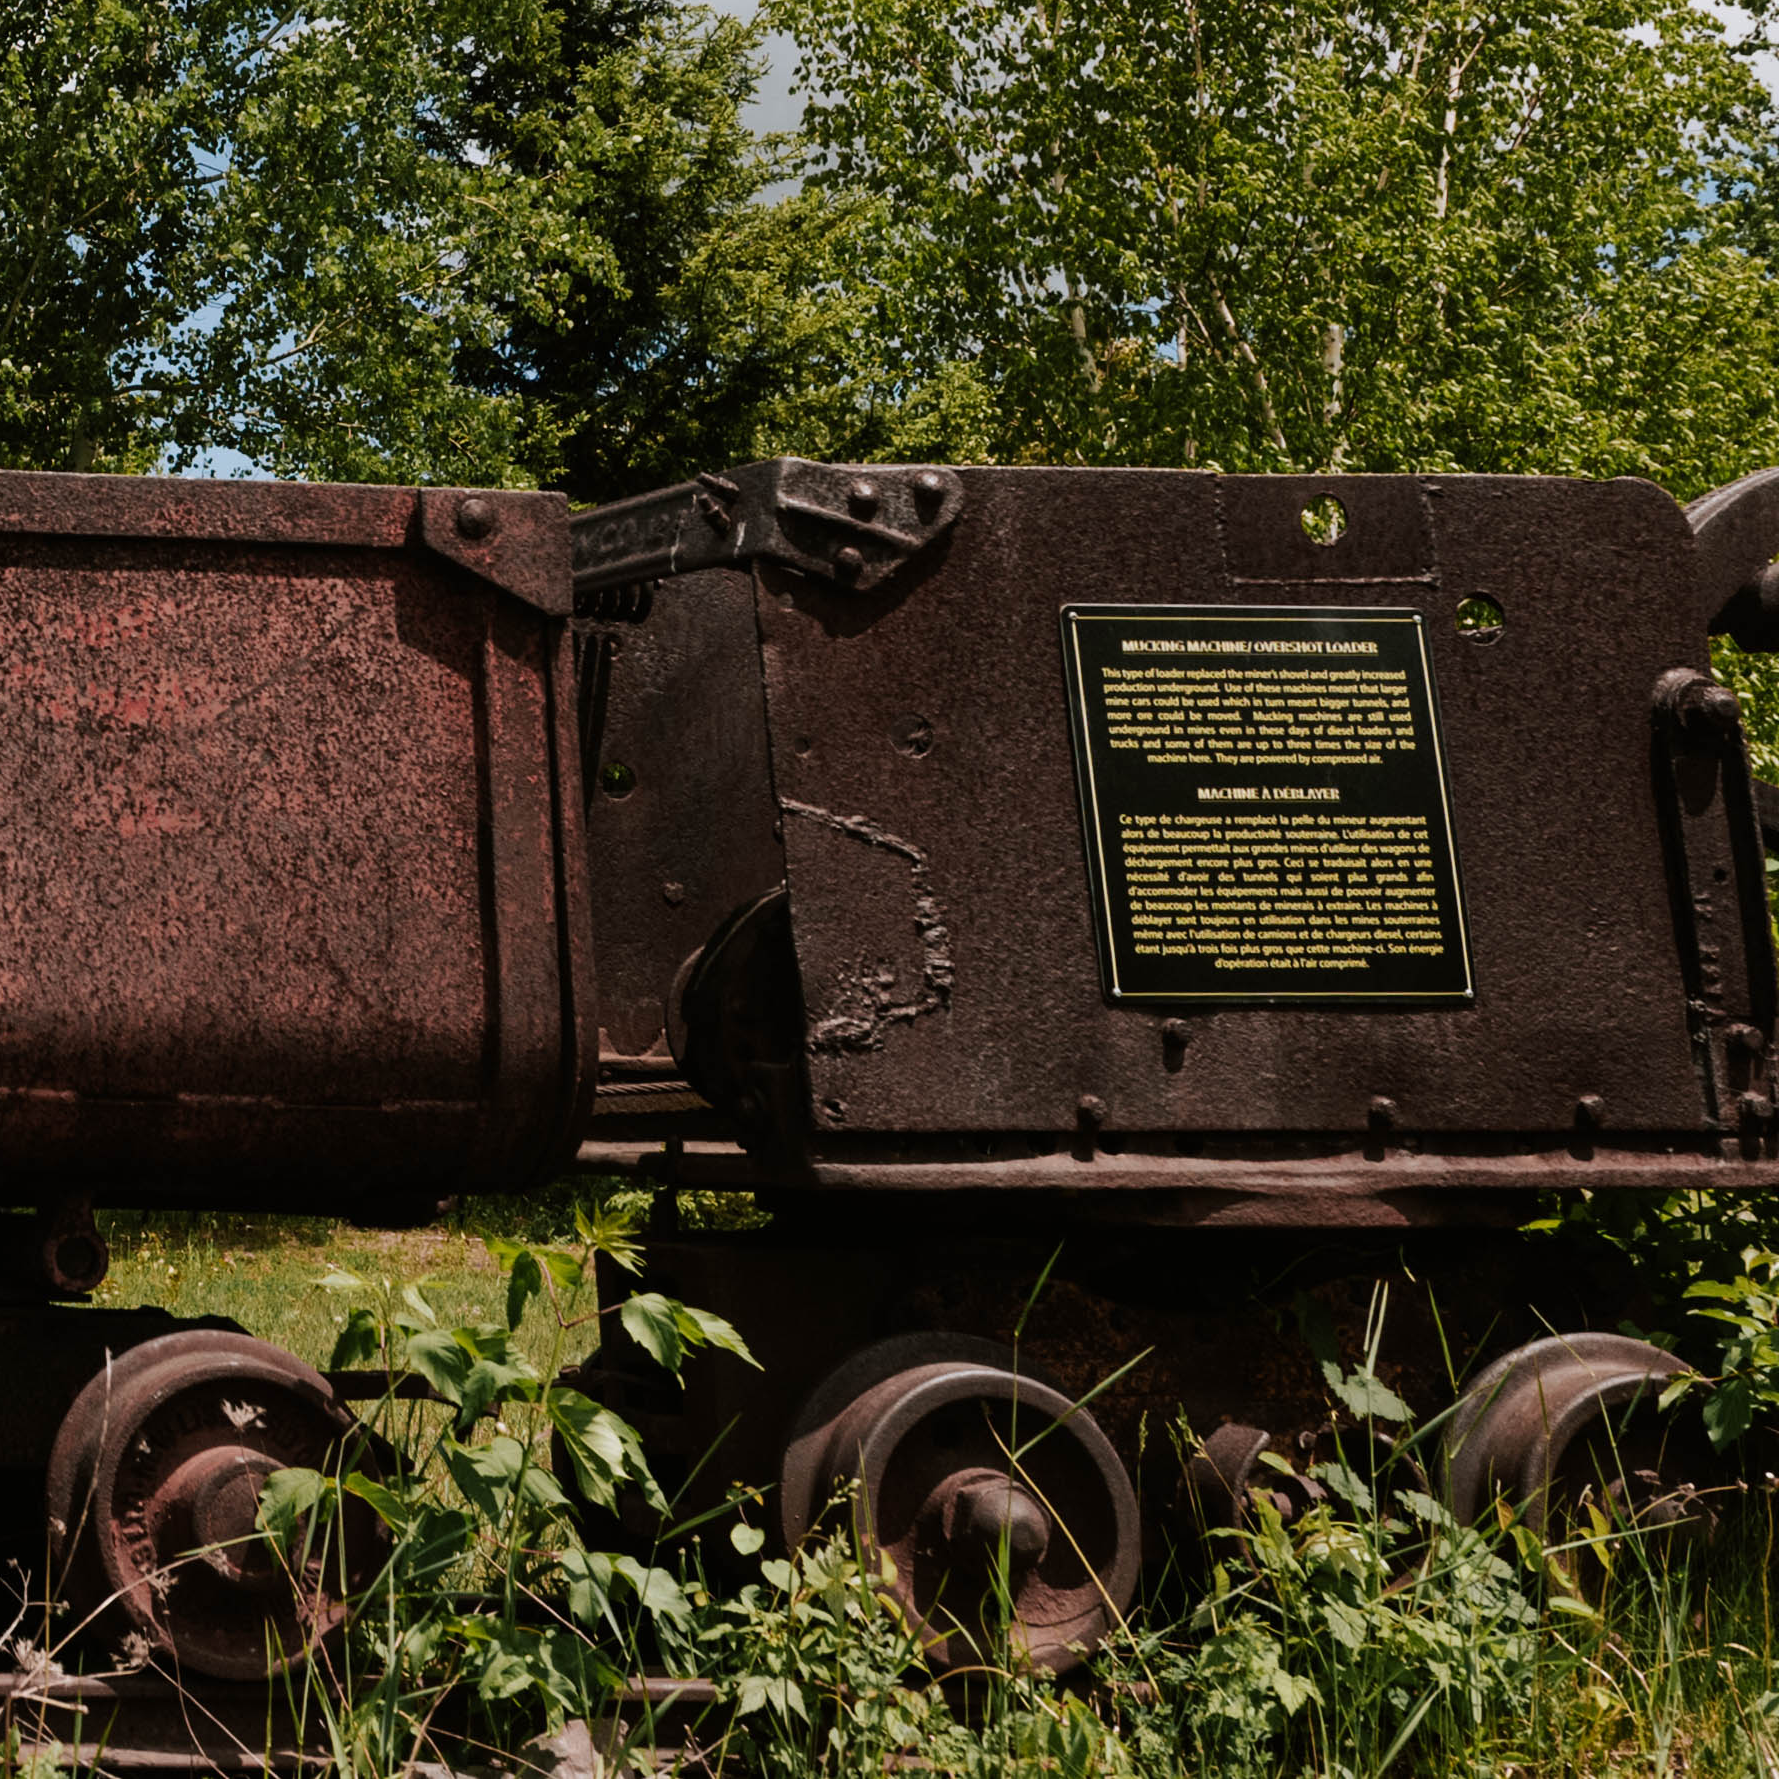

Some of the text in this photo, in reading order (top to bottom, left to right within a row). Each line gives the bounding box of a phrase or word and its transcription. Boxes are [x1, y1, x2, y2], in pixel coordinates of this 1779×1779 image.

[1122, 640, 1378, 654] MUCKING MACHINE/ OVERSHOT LOADER
[1101, 667, 1406, 681] This type of loader replaced the shovel and increased
[1103, 682, 1156, 694] production
[1224, 682, 1243, 693] Use
[1243, 682, 1254, 693] of
[1255, 682, 1282, 693] these
[1282, 683, 1327, 694] machines
[1328, 684, 1359, 694] meant
[1359, 683, 1379, 694] that
[1105, 696, 1410, 710] mine cars could be used which in turn meant bigger and
[1107, 712, 1132, 721] more
[1136, 712, 1153, 721] ore
[1157, 710, 1185, 721] could
[1189, 710, 1203, 721] be
[1252, 710, 1294, 724] Mucking
[1298, 711, 1343, 722] machines
[1347, 713, 1363, 722] are
[1388, 711, 1412, 722] used
[1108, 724, 1414, 738] underground in mines even in these days of diesel loaders and
[1109, 738, 1416, 751] trucks and some of them are up to three times the of the
[1147, 752, 1188, 763] machine
[1215, 752, 1239, 766] They
[1239, 755, 1255, 764] are
[1255, 753, 1297, 765] powered
[1297, 753, 1311, 766] by
[1311, 753, 1368, 766] compressed
[1197, 786, 1340, 800] MACHINE À DÉBLAYER
[1119, 813, 1366, 827] Ce type de chargeuse a la du mineur
[1121, 828, 1429, 841] alors de beaucoup la de cet
[1250, 843, 1430, 856] grandes mines des de
[1196, 859, 1229, 868] encore
[1233, 857, 1254, 870] plus
[1283, 857, 1305, 868] Ceci
[1370, 857, 1394, 868] alors
[1397, 859, 1410, 868] en
[1413, 859, 1432, 868] une
[1217, 871, 1409, 885] des tunnels qui plus grands
[1199, 885, 1344, 896] les mais de
[1130, 900, 1429, 912] de beaucoup les montants de Les machines
[1175, 914, 1380, 927] sont toujours en utilisation dans les mines
[1242, 929, 1256, 940] de
[1257, 929, 1297, 940] camions
[1298, 930, 1309, 940] et
[1311, 929, 1324, 940] de
[1325, 929, 1372, 942] chargeurs
[1197, 943, 1220, 954] trois
[1220, 943, 1239, 954] fois
[1240, 943, 1261, 956] plus
[1262, 945, 1284, 956] gros
[1285, 945, 1305, 956] que
[1387, 943, 1407, 954] Son
